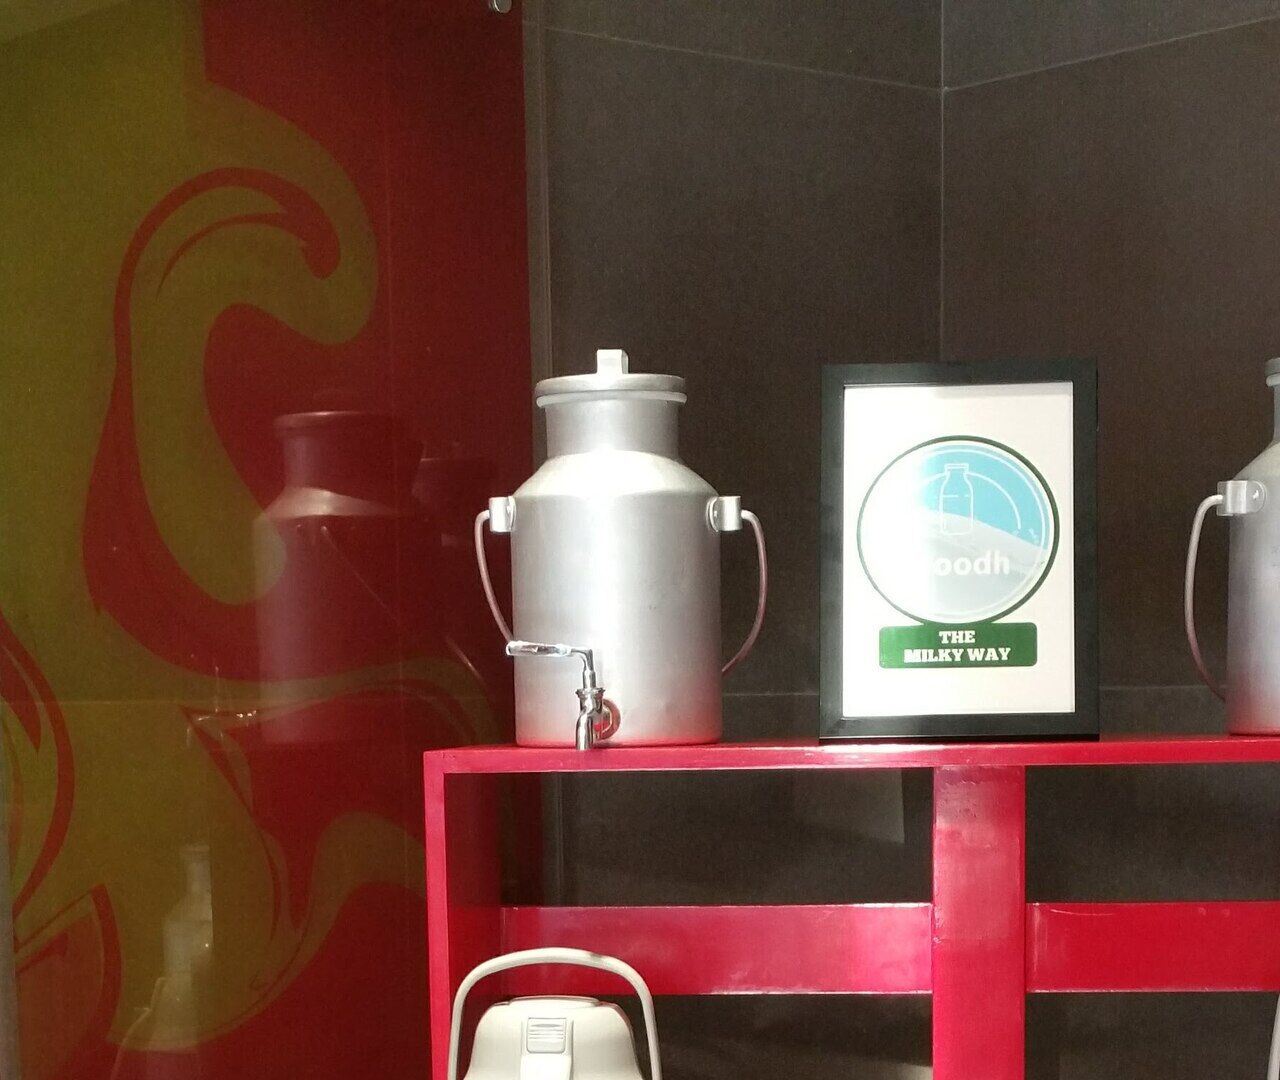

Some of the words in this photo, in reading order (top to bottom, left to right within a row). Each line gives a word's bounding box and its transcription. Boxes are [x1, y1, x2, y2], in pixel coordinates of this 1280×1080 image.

[933, 549, 1010, 575] oodh
[939, 630, 976, 644] THE
[904, 648, 965, 663] MILKY
[966, 648, 1011, 662] WAY
